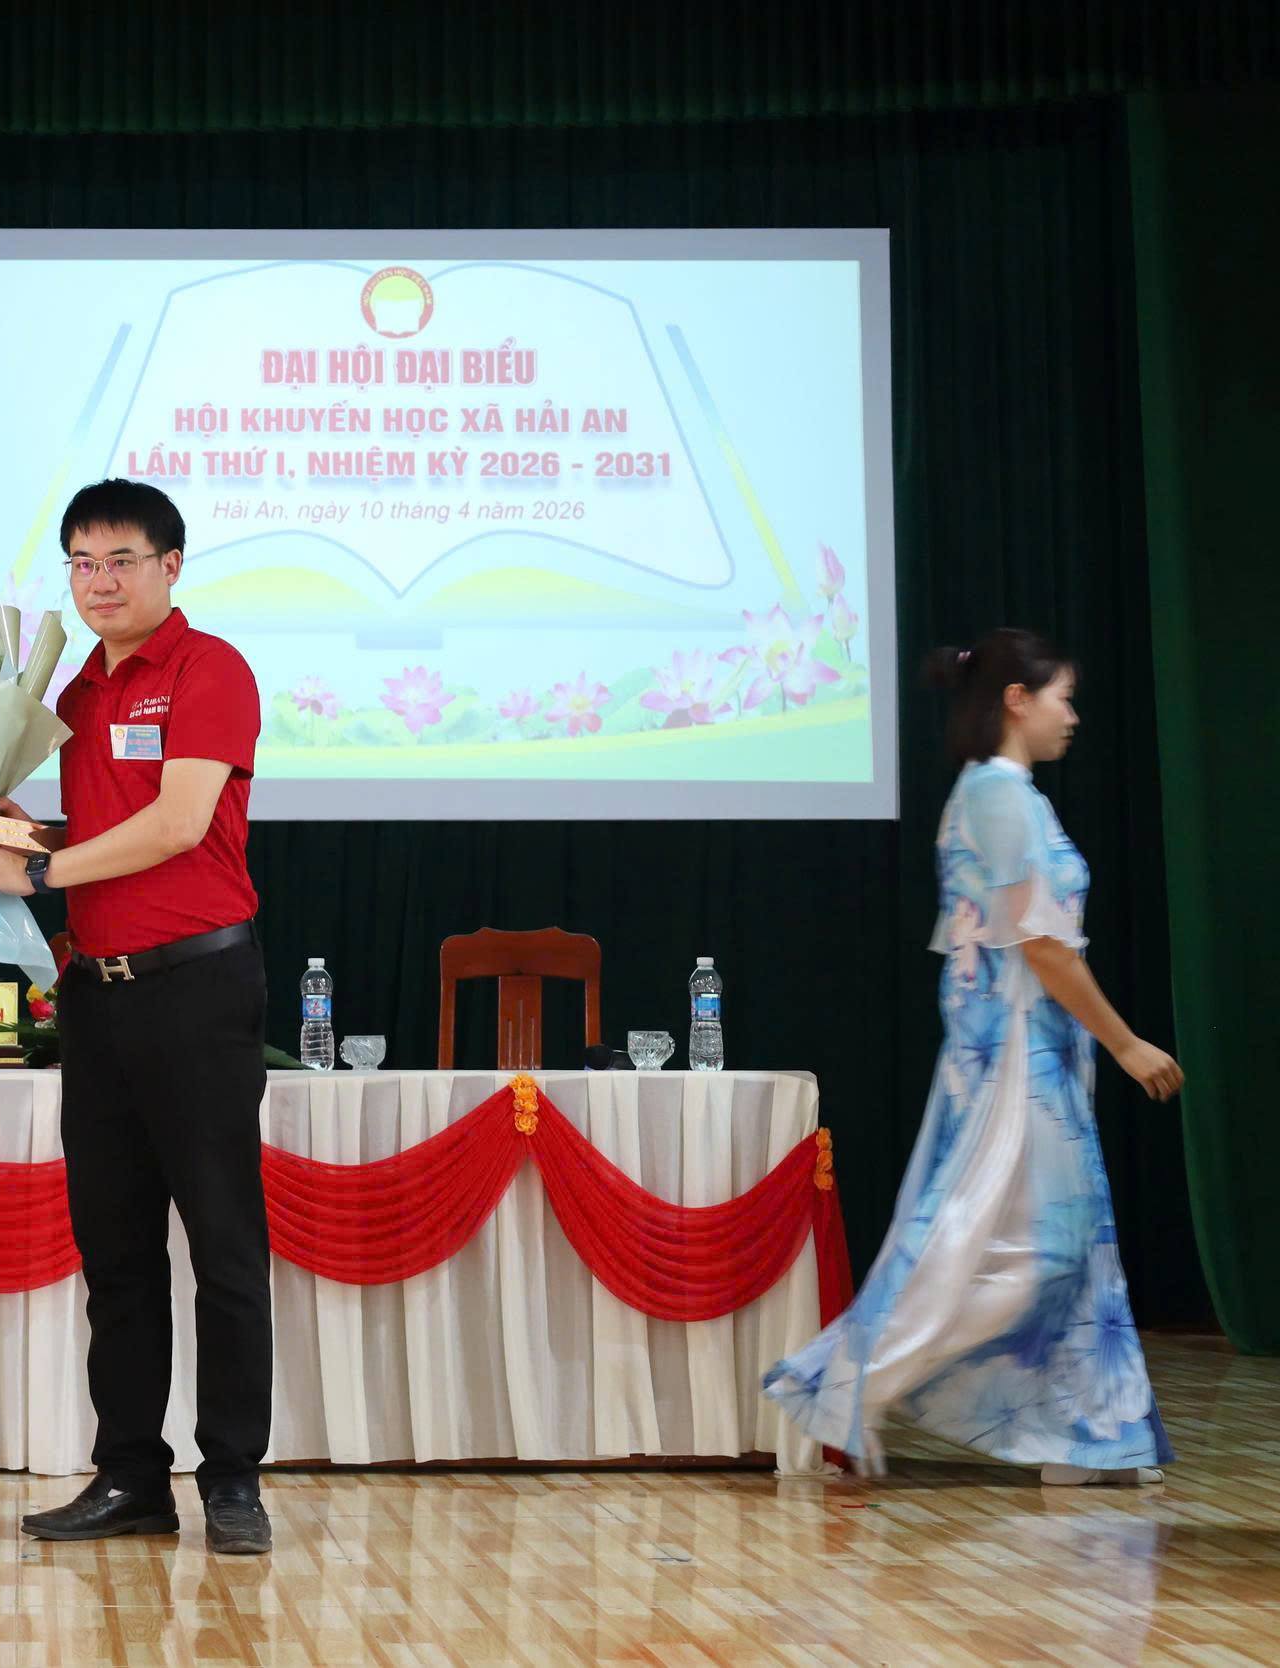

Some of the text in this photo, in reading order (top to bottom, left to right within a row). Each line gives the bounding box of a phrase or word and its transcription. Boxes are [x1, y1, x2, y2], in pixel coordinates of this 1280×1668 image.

[261, 337, 536, 390] ĐẠI HỘI ĐẠI BIỂU
[174, 399, 628, 438] HỘI KHUYẾN HỌC XÃ HẢI AN
[127, 442, 192, 477] LẦN
[202, 445, 268, 477] THỨ
[276, 451, 296, 479] I,
[308, 446, 416, 482] NHIỆM
[427, 446, 469, 477] KỲ
[480, 451, 561, 477] 2026
[594, 451, 671, 477] 2031
[212, 499, 249, 520] Hải
[297, 498, 351, 525] ngày
[360, 500, 384, 520] 10
[390, 500, 451, 525] tháng
[457, 500, 471, 520] 4
[477, 501, 525, 520] năm
[531, 500, 586, 521] 2026
